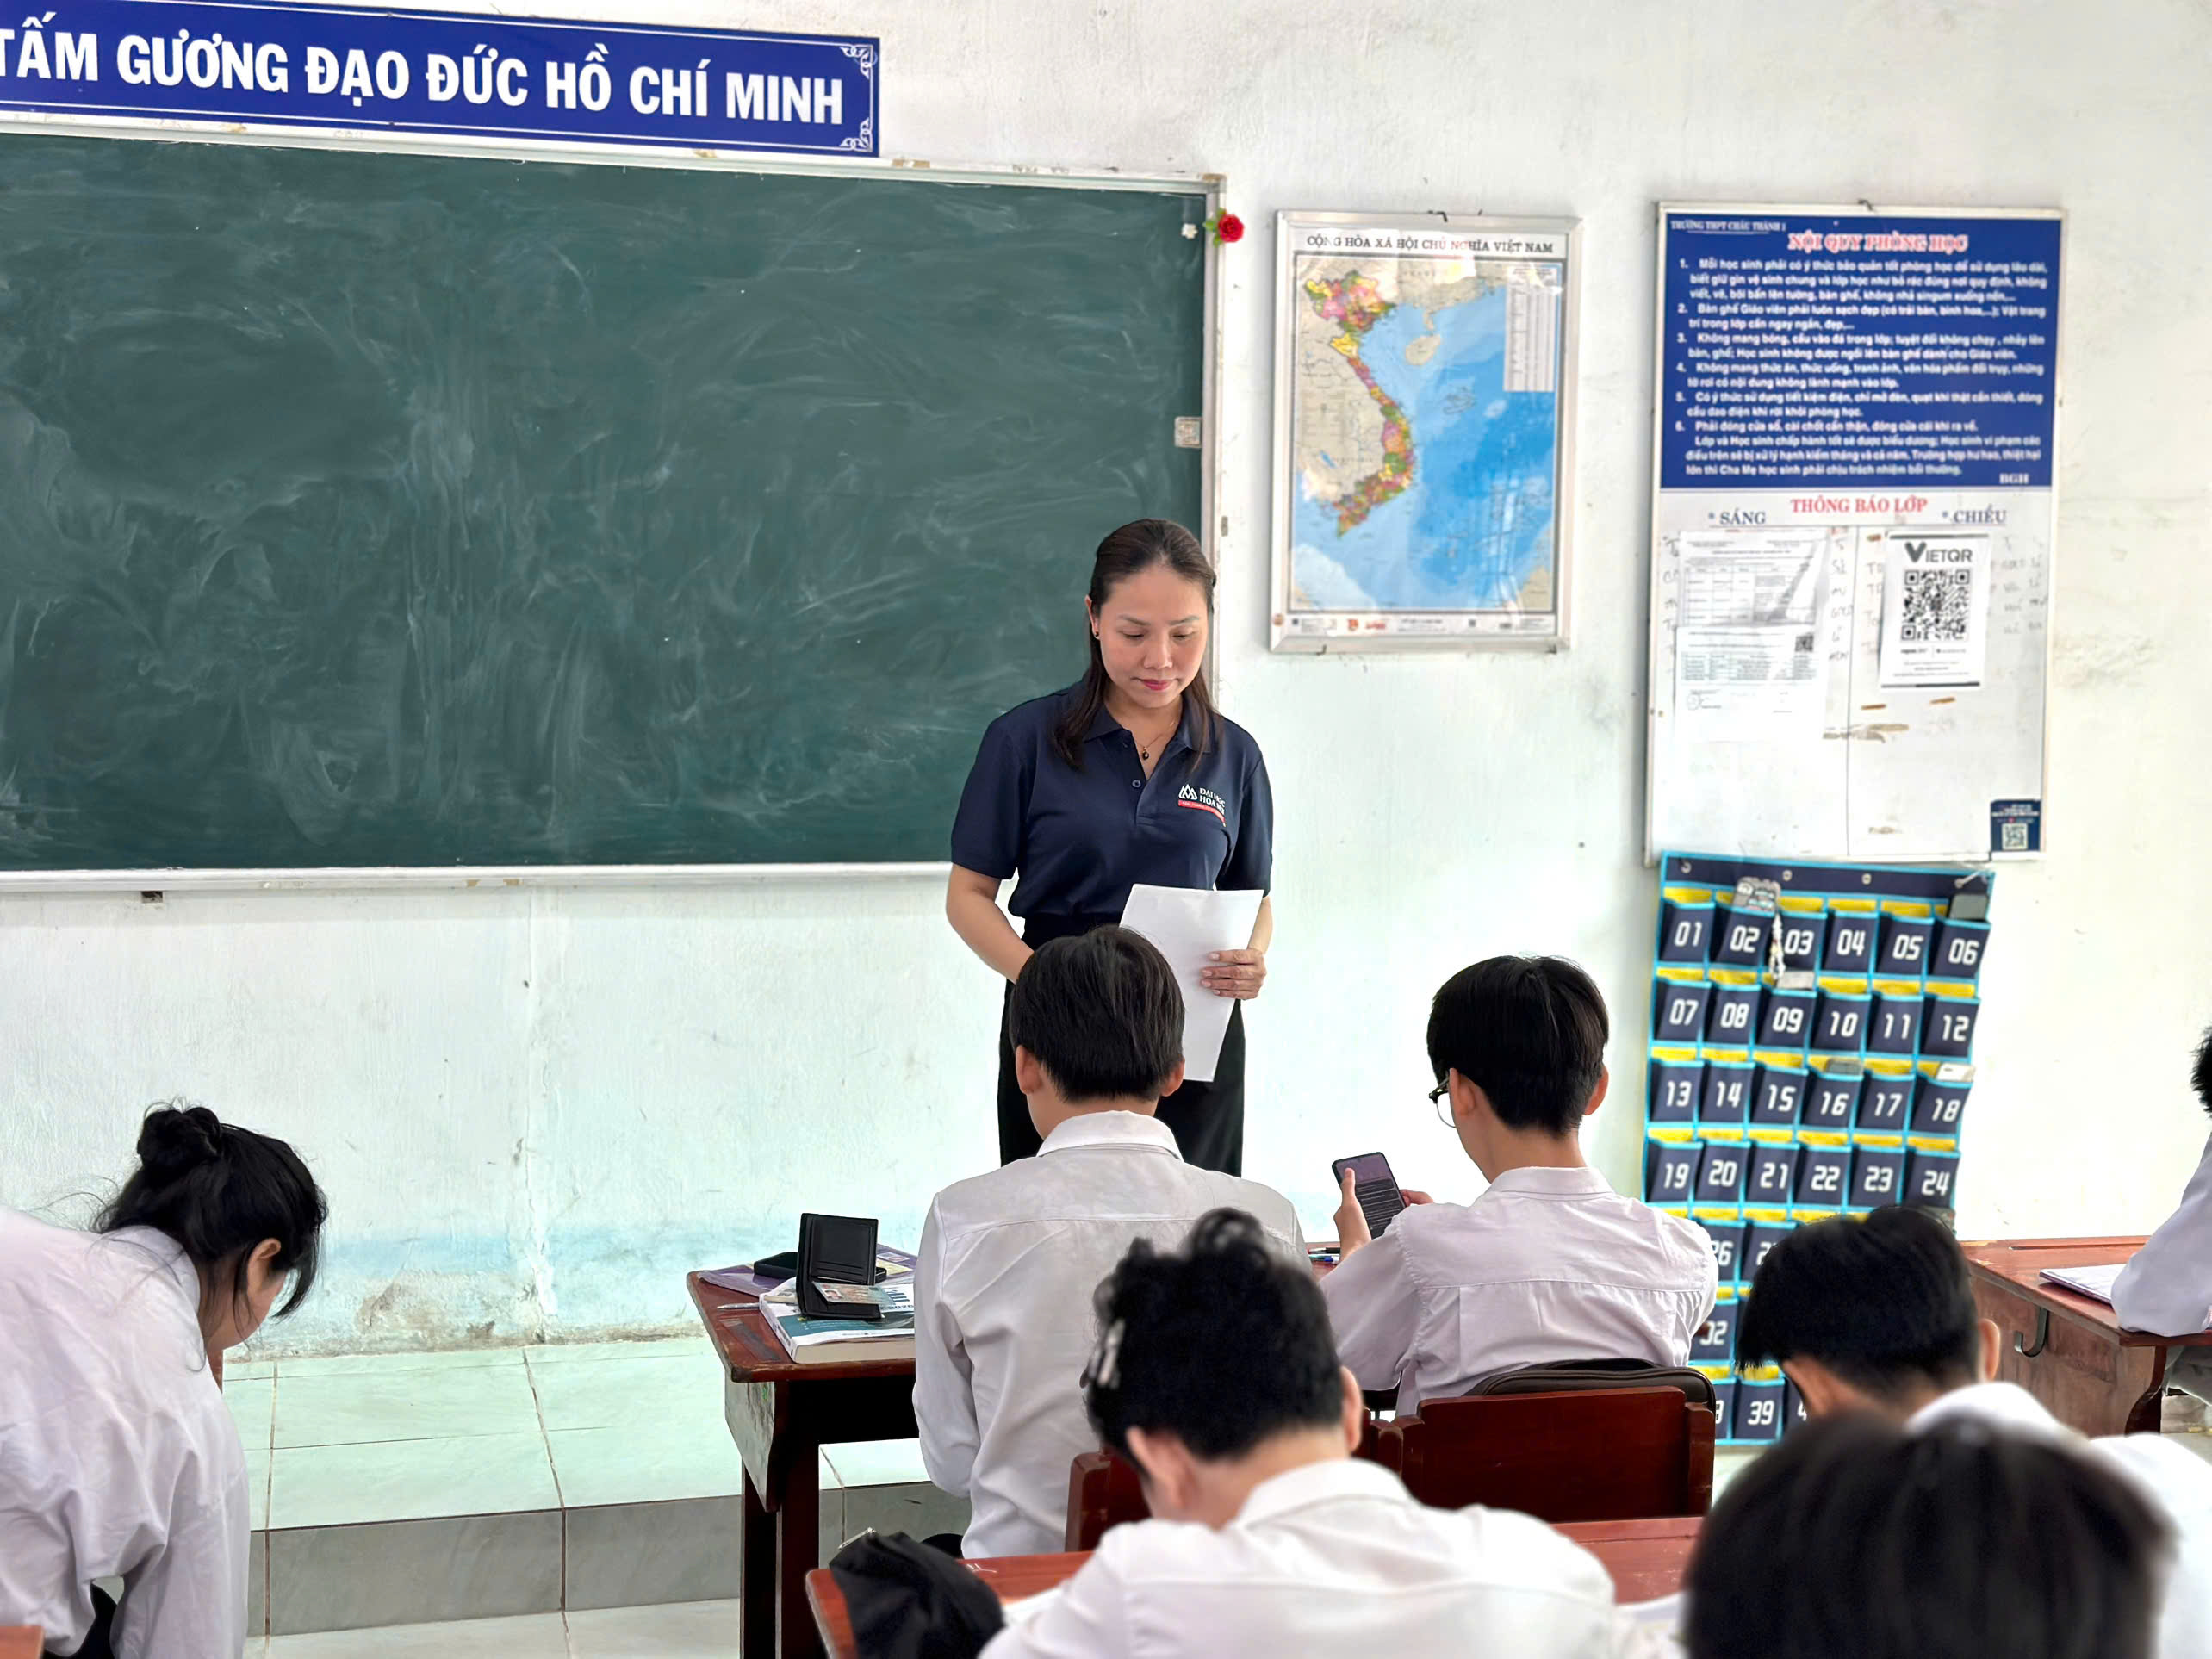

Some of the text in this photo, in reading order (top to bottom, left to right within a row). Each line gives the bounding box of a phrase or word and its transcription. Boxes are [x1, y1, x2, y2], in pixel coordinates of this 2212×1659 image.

[0, 12, 843, 126] TẤM GƯƠNG ĐẠO ĐỨC HỒ CHÍ MINH
[1706, 221, 1727, 230] THPT
[1345, 234, 1371, 248] HÒA
[1397, 236, 1419, 250] HỘI
[1422, 236, 1446, 249] CHỦ
[1494, 239, 1522, 253] VIỆT
[1525, 243, 1553, 253] NAM
[1787, 230, 1968, 254] NỘI QUY PHÒNG HỌC
[1999, 473, 2029, 484] BGH
[1719, 507, 1767, 525] SÁNG
[1791, 494, 1928, 513] THÔNG BÁO LỚP
[1904, 541, 1973, 563] VIETQR
[1675, 922, 1702, 946] 01
[1730, 926, 1760, 952] 02
[1785, 930, 1813, 955] 03
[1837, 929, 1865, 955] 04
[1893, 935, 1923, 960] 05
[1949, 939, 1979, 964] 06
[1670, 999, 1698, 1025] 07
[1721, 1003, 1749, 1028] 08
[1773, 1007, 1803, 1033] 09
[1830, 1011, 1858, 1036] 10
[1885, 1014, 1911, 1039] 11
[1943, 1015, 1969, 1041] 12
[1667, 1081, 1692, 1107] 13
[1717, 1082, 1742, 1107] 14
[1768, 1084, 1795, 1111] 15
[1821, 1092, 1849, 1115] 16
[1875, 1093, 1902, 1116] 17
[1933, 1099, 1960, 1122] 18
[1664, 1163, 1689, 1188] 19
[1709, 1159, 1737, 1186] 20
[1761, 1163, 1788, 1188] 21
[1811, 1165, 1840, 1190] 22
[1865, 1166, 1893, 1192] 23
[1922, 1171, 1949, 1195] 24
[1756, 1241, 1777, 1265] 2
[1748, 1401, 1774, 1425] 39
[1798, 1400, 1807, 1421] 4
